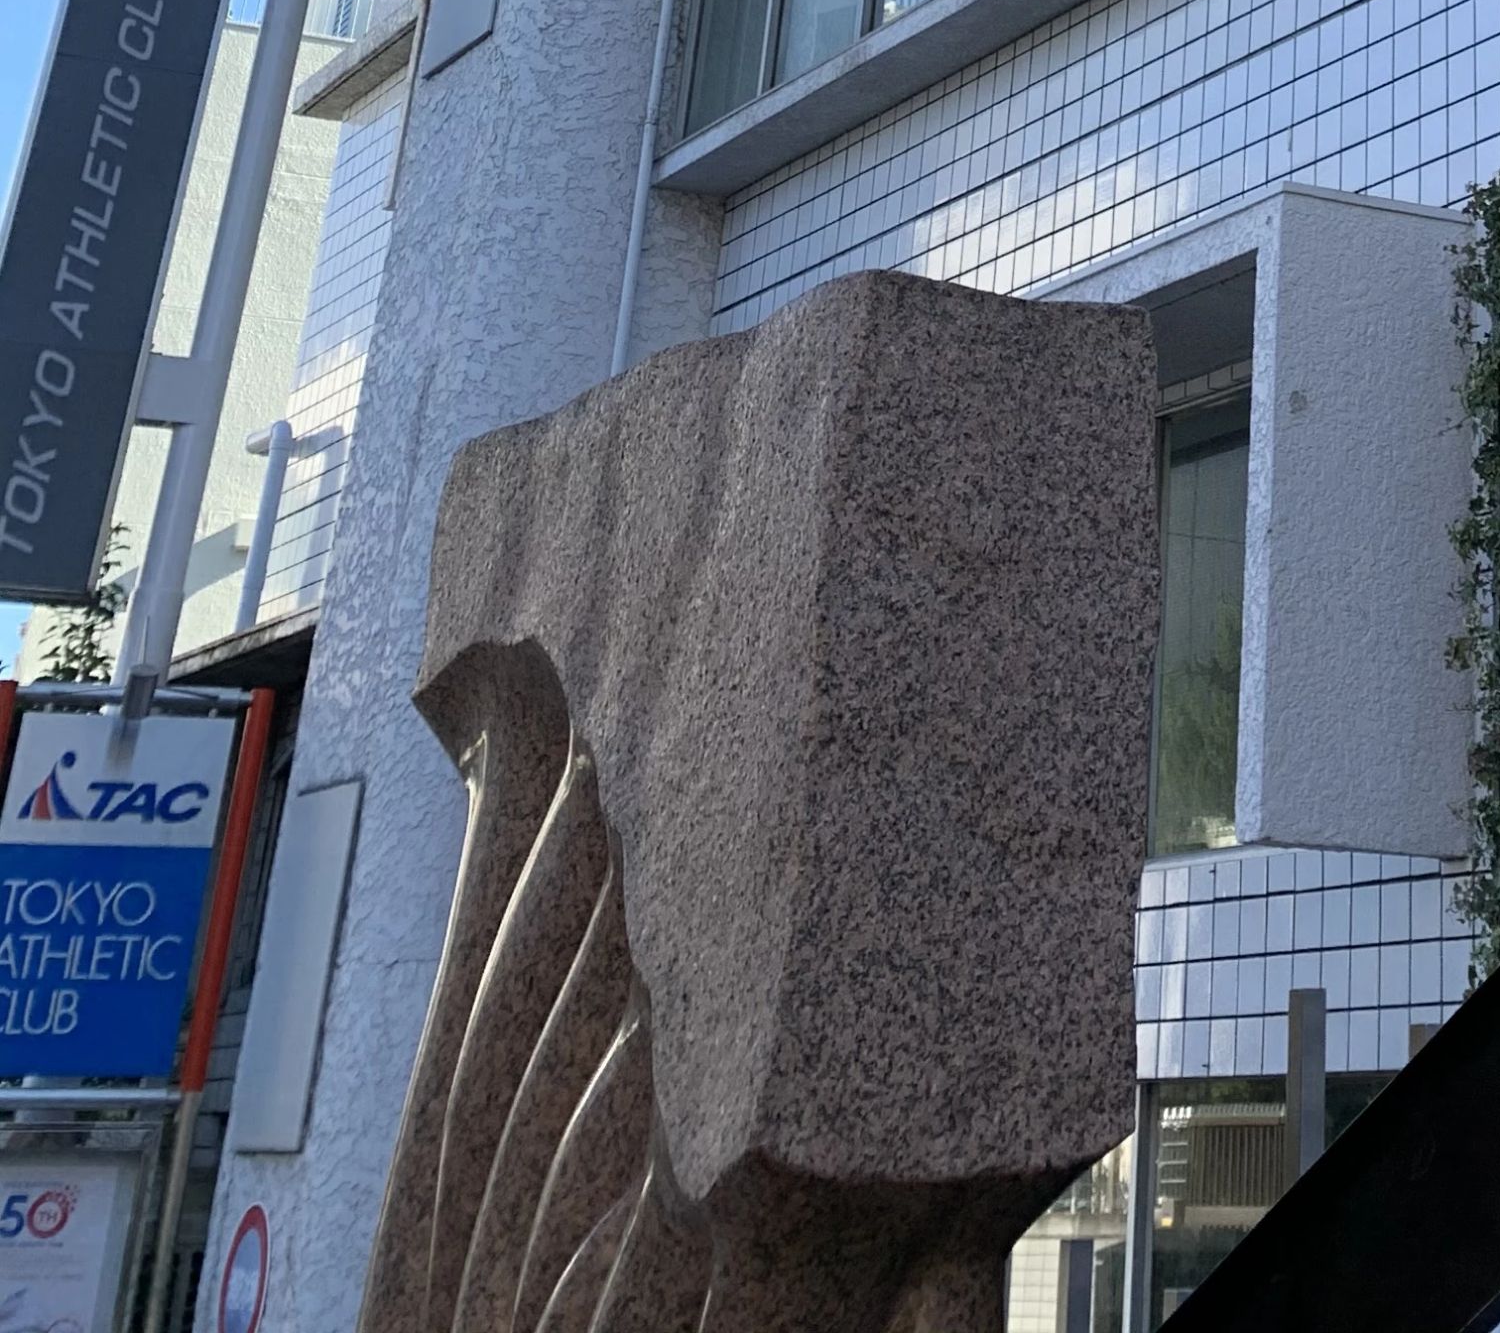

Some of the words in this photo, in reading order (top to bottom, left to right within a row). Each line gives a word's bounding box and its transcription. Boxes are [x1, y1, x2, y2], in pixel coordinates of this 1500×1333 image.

[50, 63, 142, 341] ATHLETIC
[87, 781, 209, 822] TAC
[3, 878, 157, 926] TOKYO
